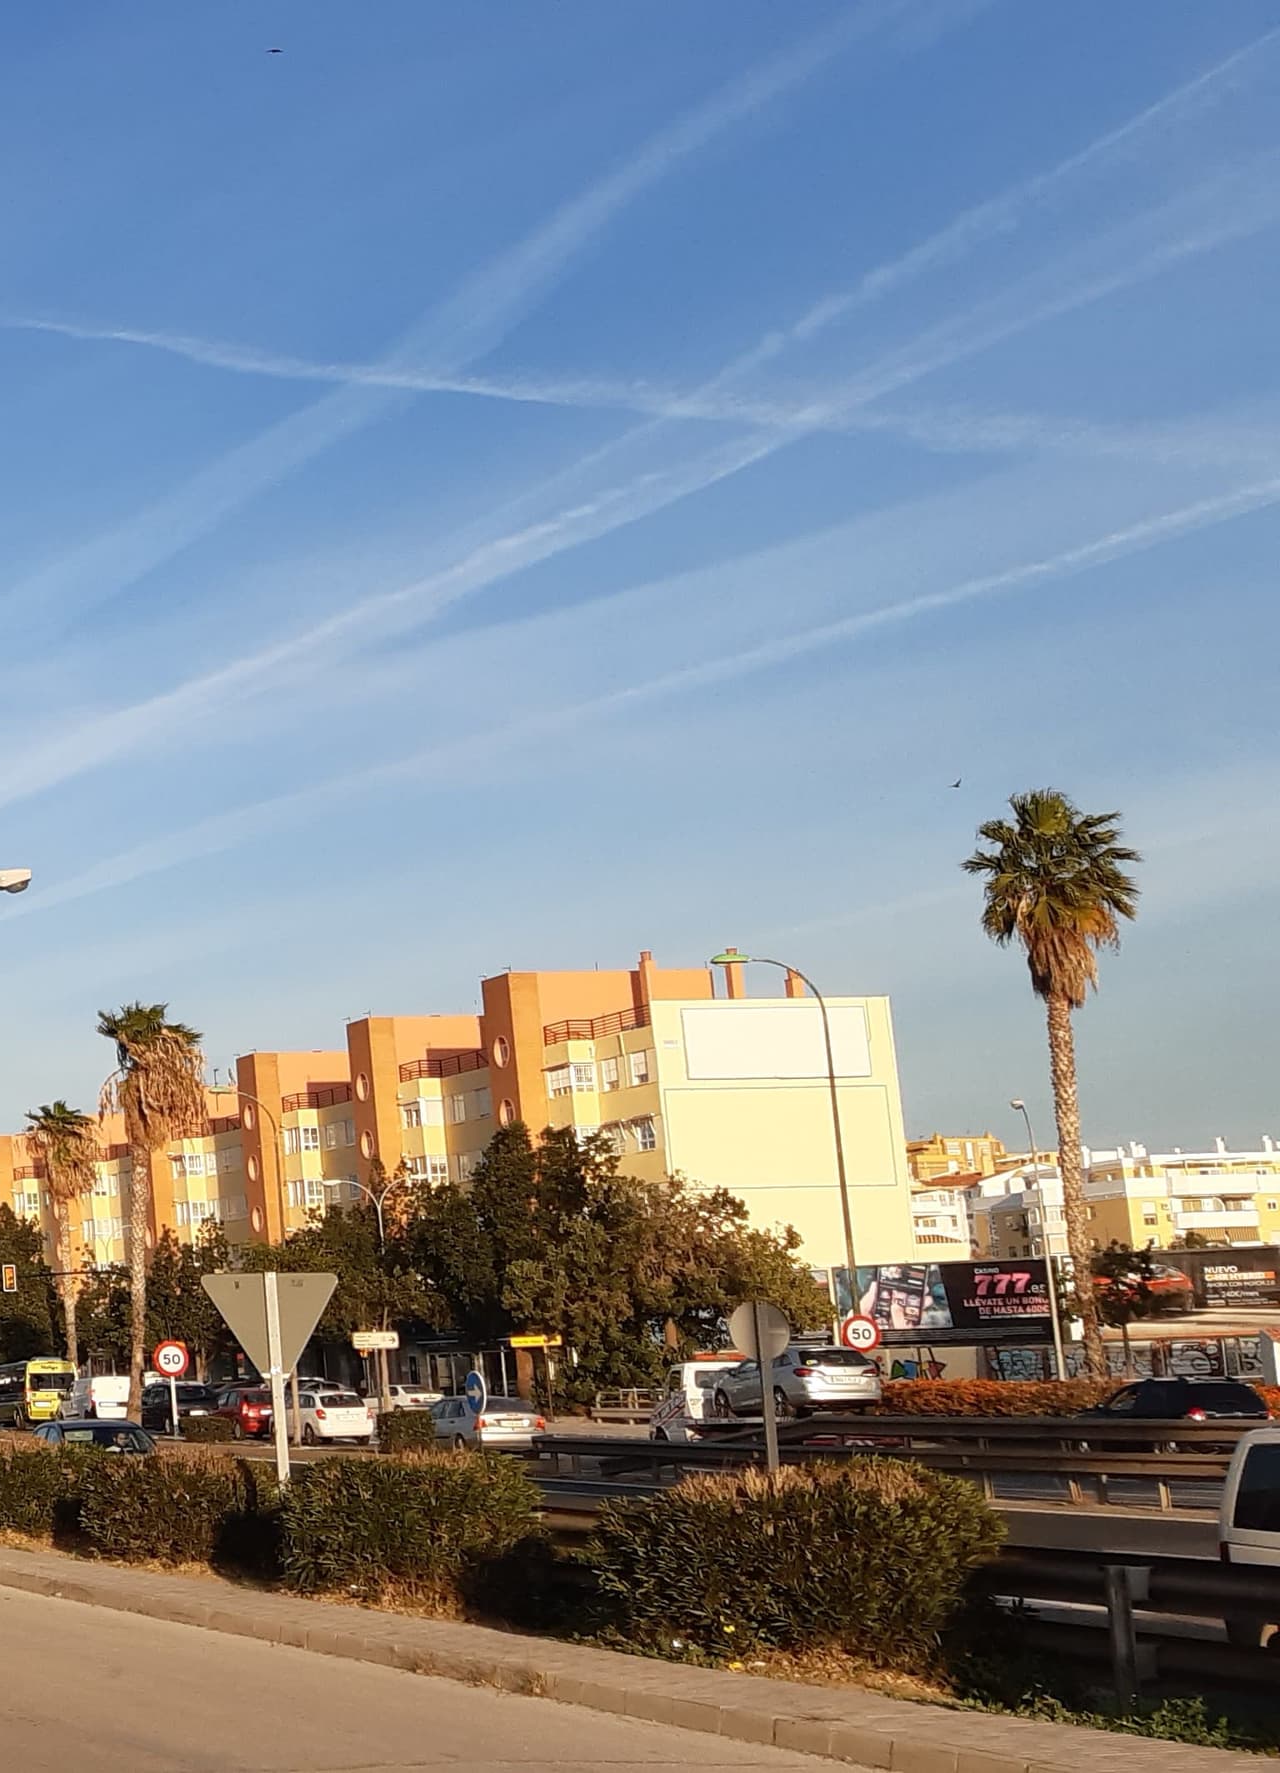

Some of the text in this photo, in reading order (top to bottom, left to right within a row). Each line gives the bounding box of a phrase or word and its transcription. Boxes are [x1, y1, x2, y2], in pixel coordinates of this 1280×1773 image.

[963, 1296, 1004, 1307] LLÉVATE
[1005, 1298, 1020, 1306] UN
[979, 1306, 992, 1315] DE
[993, 1305, 1025, 1314] HASTA
[852, 1328, 872, 1340] 50
[163, 1353, 181, 1365] 50
